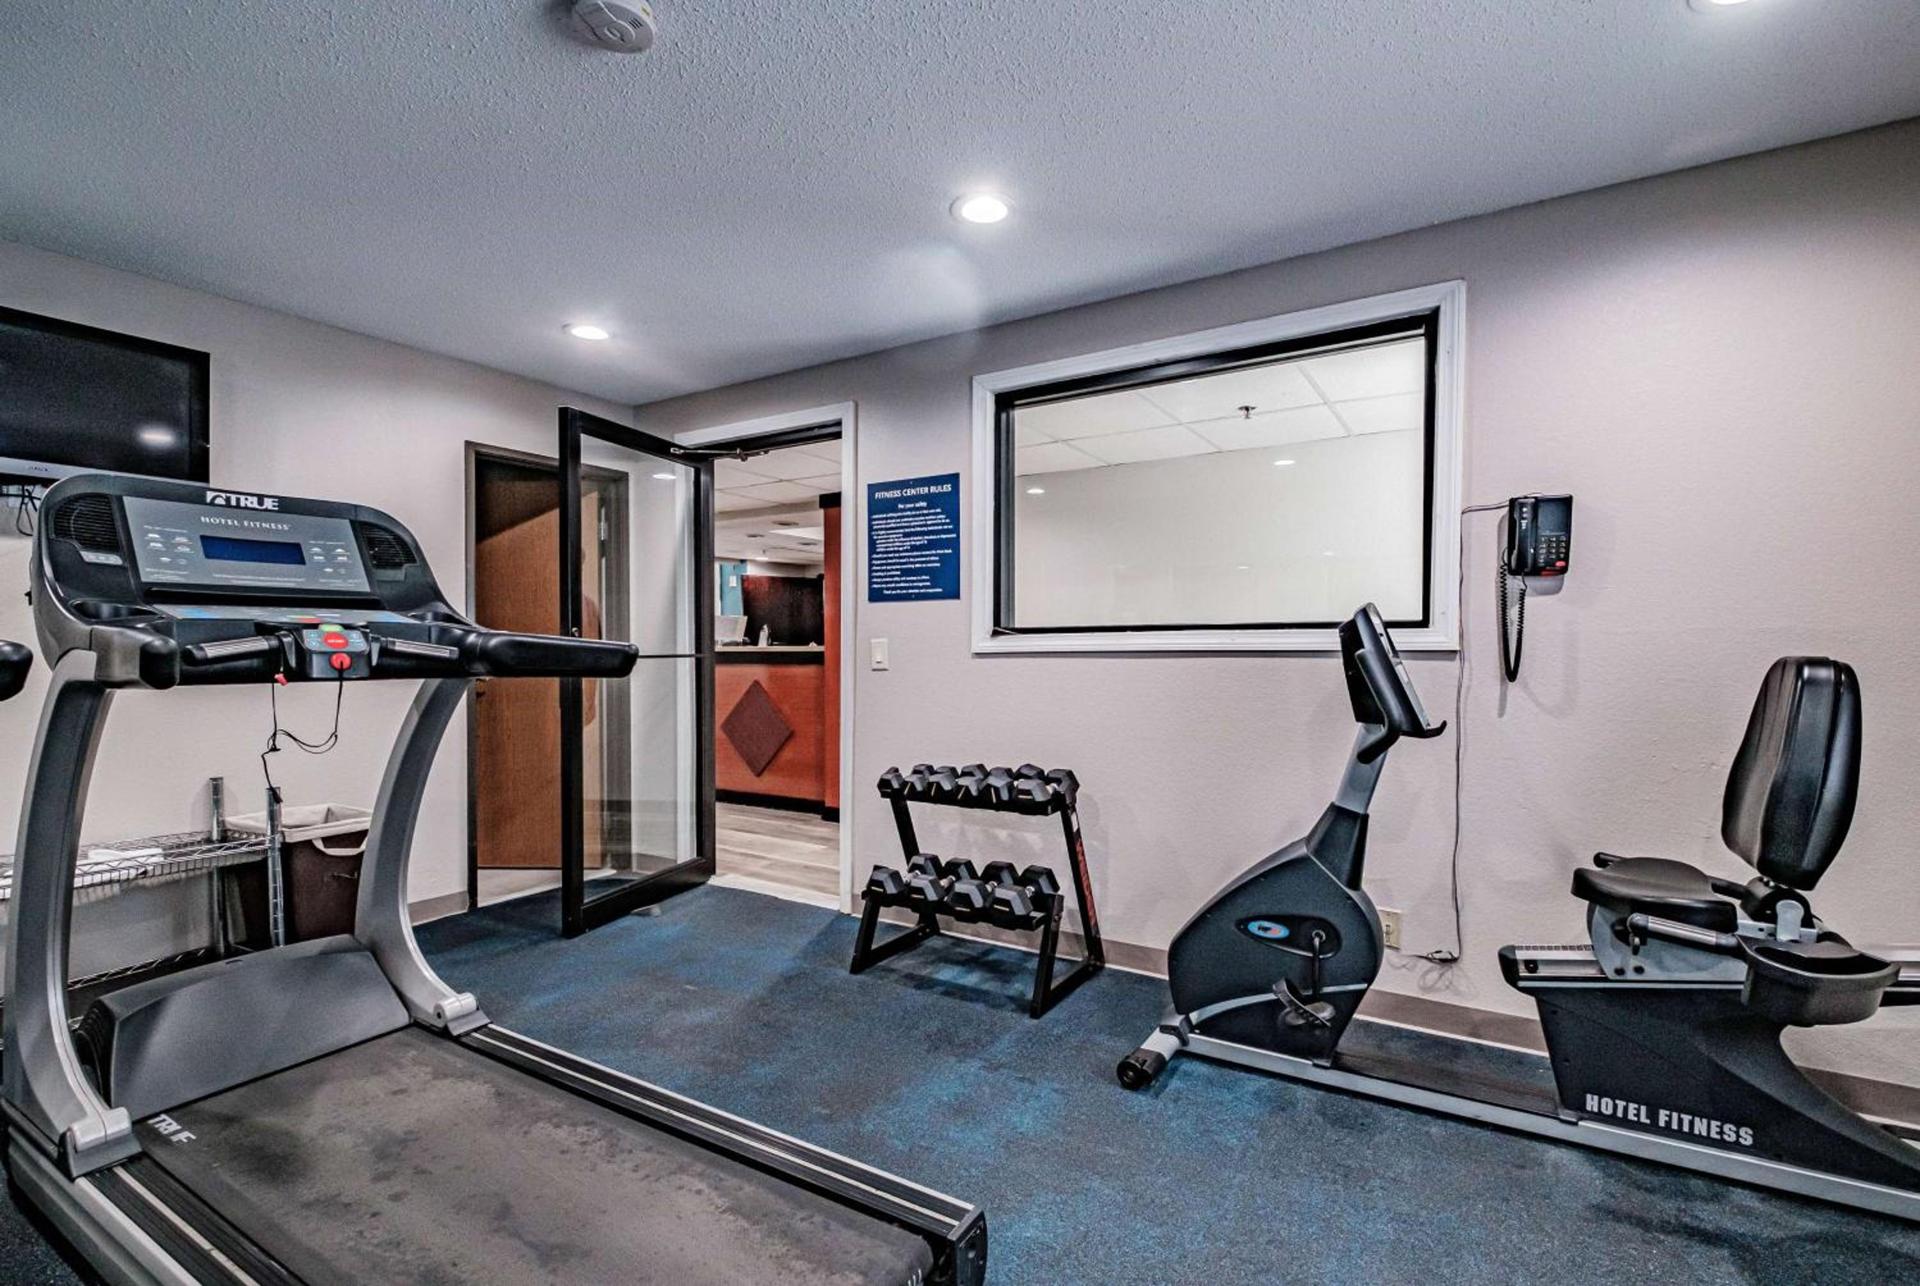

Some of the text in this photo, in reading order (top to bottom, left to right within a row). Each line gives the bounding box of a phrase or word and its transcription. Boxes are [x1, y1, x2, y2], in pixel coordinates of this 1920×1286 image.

[875, 484, 952, 499] FITNESS CENTER RULES
[225, 493, 279, 510] TRUE
[200, 516, 289, 531] HOTEL FITNESS
[1585, 1093, 1753, 1146] HOTEL FITNESS
